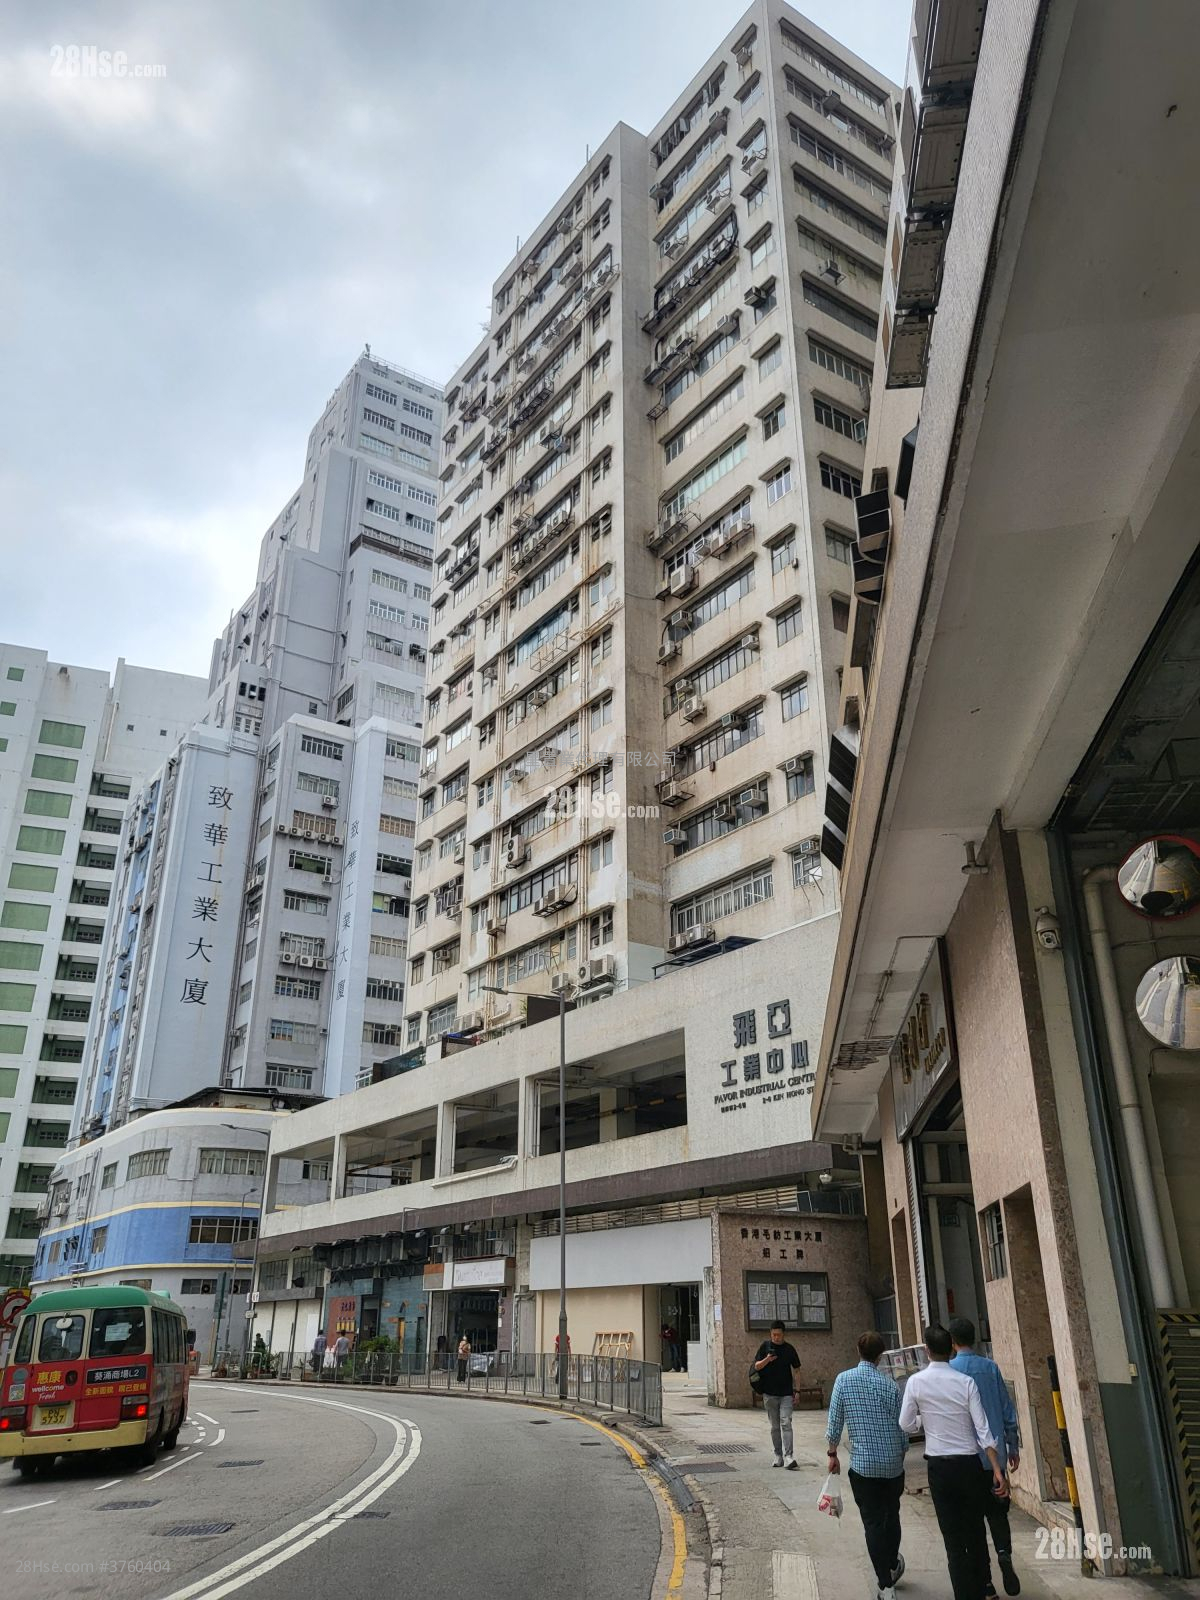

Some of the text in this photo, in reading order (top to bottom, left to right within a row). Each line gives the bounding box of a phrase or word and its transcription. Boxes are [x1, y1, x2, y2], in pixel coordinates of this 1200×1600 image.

[181, 784, 234, 1006] 致華工業大廈
[336, 819, 360, 1001] 致華工業大廈
[720, 1040, 809, 1088] 工業中心
[739, 1080, 786, 1098] INDUSTRIAL
[787, 1072, 817, 1087] CENTR
[32, 1384, 65, 1393] wellcome
[37, 1370, 62, 1385] 惠康
